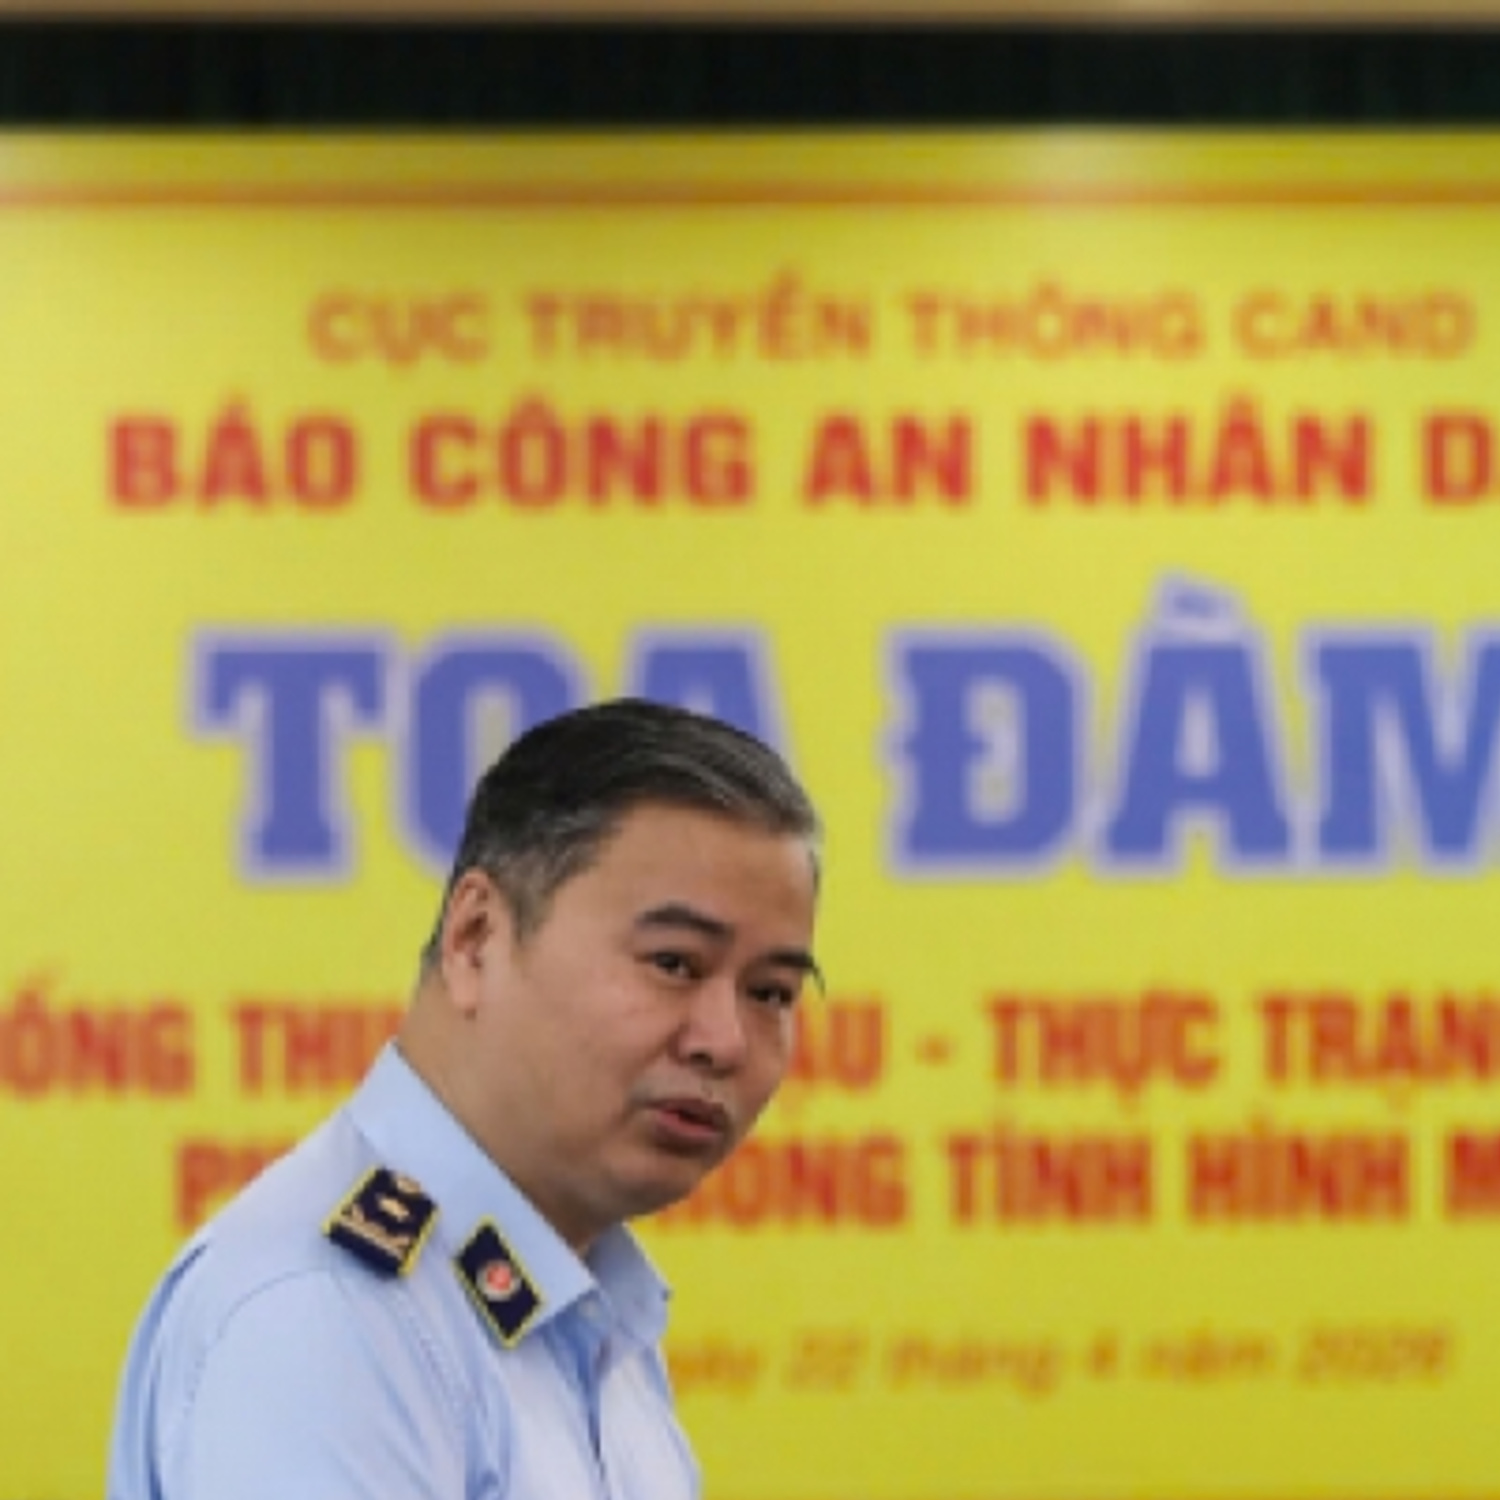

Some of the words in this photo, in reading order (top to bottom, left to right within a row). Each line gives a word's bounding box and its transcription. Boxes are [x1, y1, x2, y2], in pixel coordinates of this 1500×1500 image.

[110, 393, 358, 508] BÁO
[412, 393, 754, 510] CÔNG
[805, 415, 971, 508] AN
[1024, 392, 1370, 506] NHÂN
[988, 990, 1220, 1112] THỰC
[948, 1112, 1152, 1226] TÌNH
[1188, 1108, 1410, 1224] HÌNH
